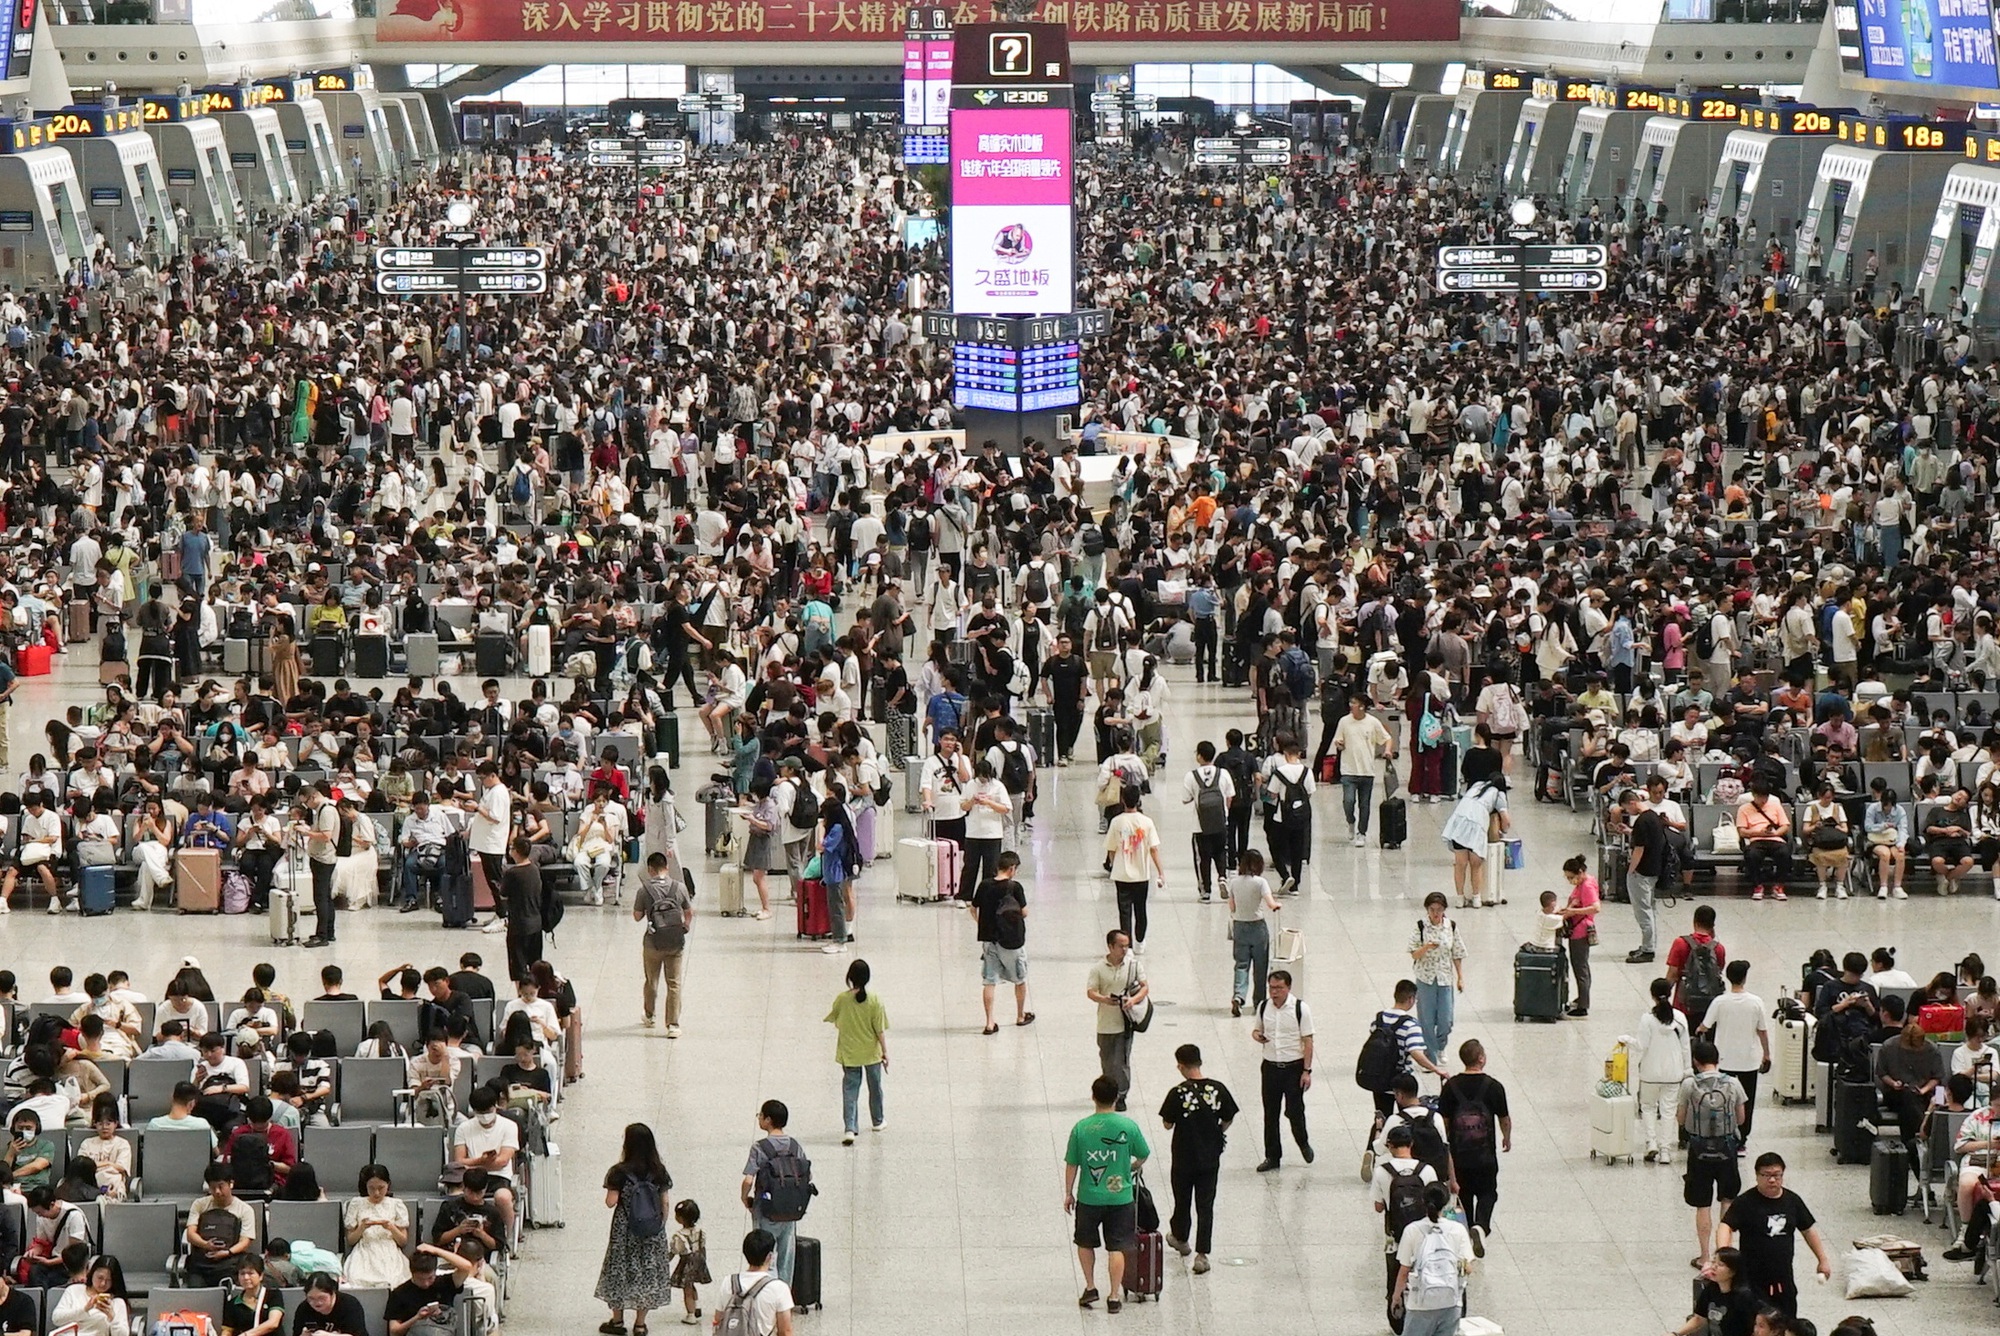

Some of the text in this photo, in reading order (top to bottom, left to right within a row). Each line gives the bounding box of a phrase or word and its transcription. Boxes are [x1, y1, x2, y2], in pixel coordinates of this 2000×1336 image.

[953, 1, 1387, 33] 奋创铁路高质量发展新局面！
[1046, 62, 1060, 77] 西
[318, 76, 346, 89] 28A
[1493, 74, 1520, 88] 28B
[263, 85, 284, 99] 6A
[1003, 91, 1048, 103] 12306
[1627, 91, 1659, 107] 24B
[143, 103, 169, 120] 2A
[1702, 101, 1736, 118] 22B
[53, 115, 91, 133] 20A
[1793, 113, 1831, 131] 20B
[978, 134, 1043, 153] 高端实木地板
[1902, 126, 1944, 147] 18B
[975, 268, 1049, 286] 久盛地板
